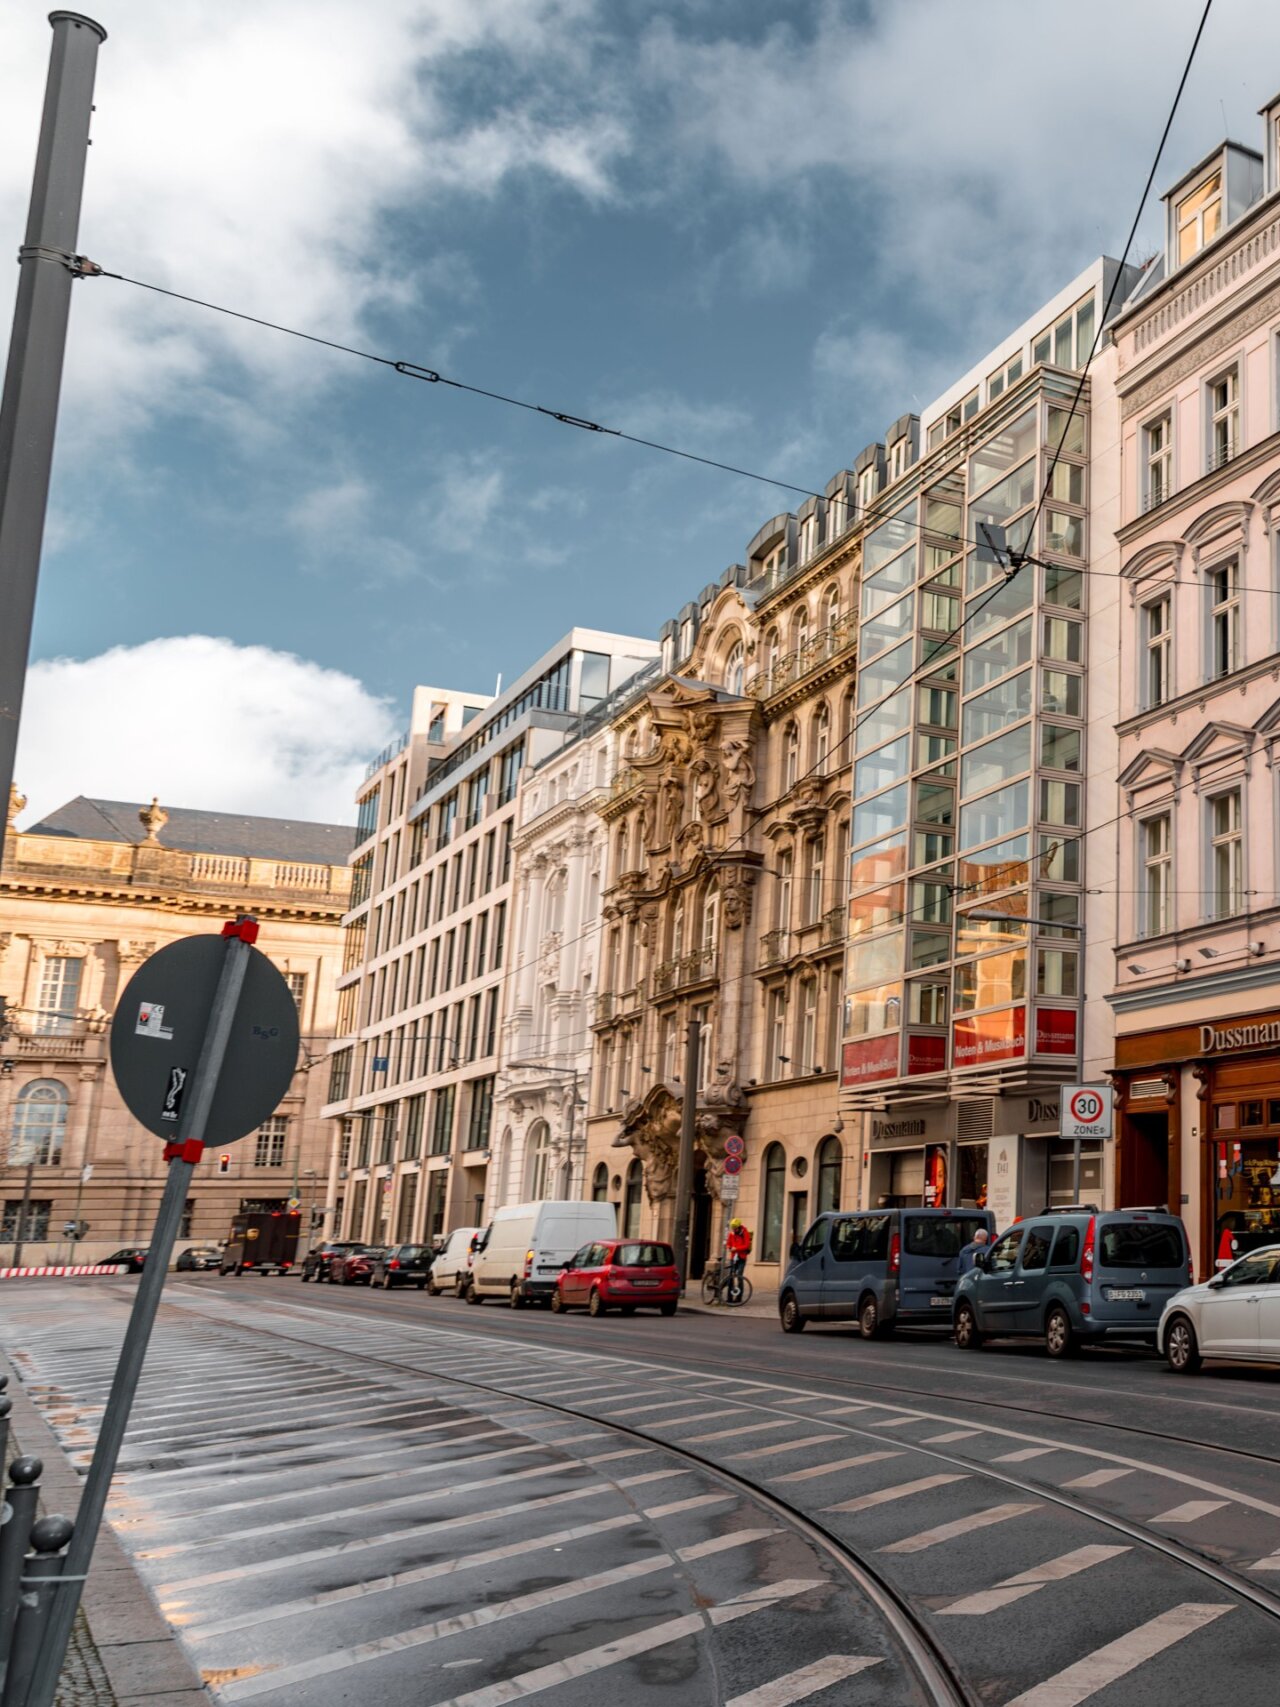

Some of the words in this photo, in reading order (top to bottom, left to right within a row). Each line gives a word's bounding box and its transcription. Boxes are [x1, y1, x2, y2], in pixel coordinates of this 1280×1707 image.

[955, 1045, 976, 1058] Noten
[977, 1041, 983, 1054] &
[1028, 1099, 1060, 1122] Duss
[1077, 1098, 1097, 1115] 30
[872, 1119, 926, 1139] Dussmann
[1073, 1125, 1099, 1135] ZONE
